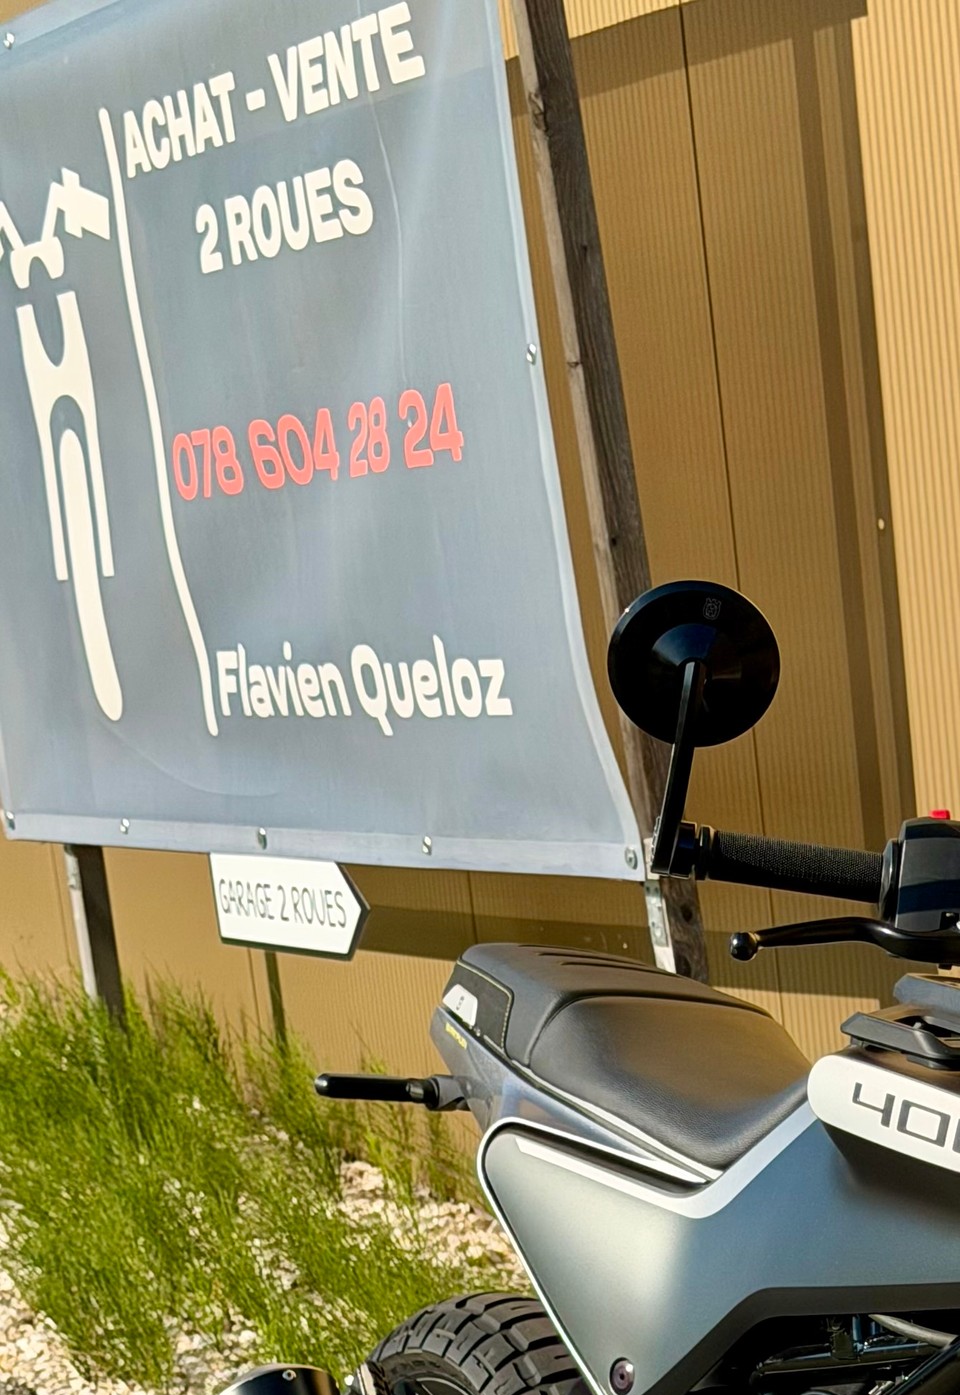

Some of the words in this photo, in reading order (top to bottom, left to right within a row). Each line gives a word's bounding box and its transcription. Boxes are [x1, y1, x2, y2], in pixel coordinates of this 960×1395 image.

[123, 71, 236, 179] ACHAT
[245, 89, 267, 111] -
[266, 2, 427, 122] VENTE
[195, 203, 225, 275] 2
[225, 158, 375, 266] ROUES
[172, 424, 244, 500] 078
[248, 407, 340, 489] 604
[347, 396, 391, 478] 28
[398, 382, 465, 469] 24
[216, 641, 352, 719] Flavien
[350, 634, 514, 737] Queloz
[218, 878, 275, 920] GARAGE
[277, 884, 290, 922] 2
[290, 886, 348, 928] ROUES
